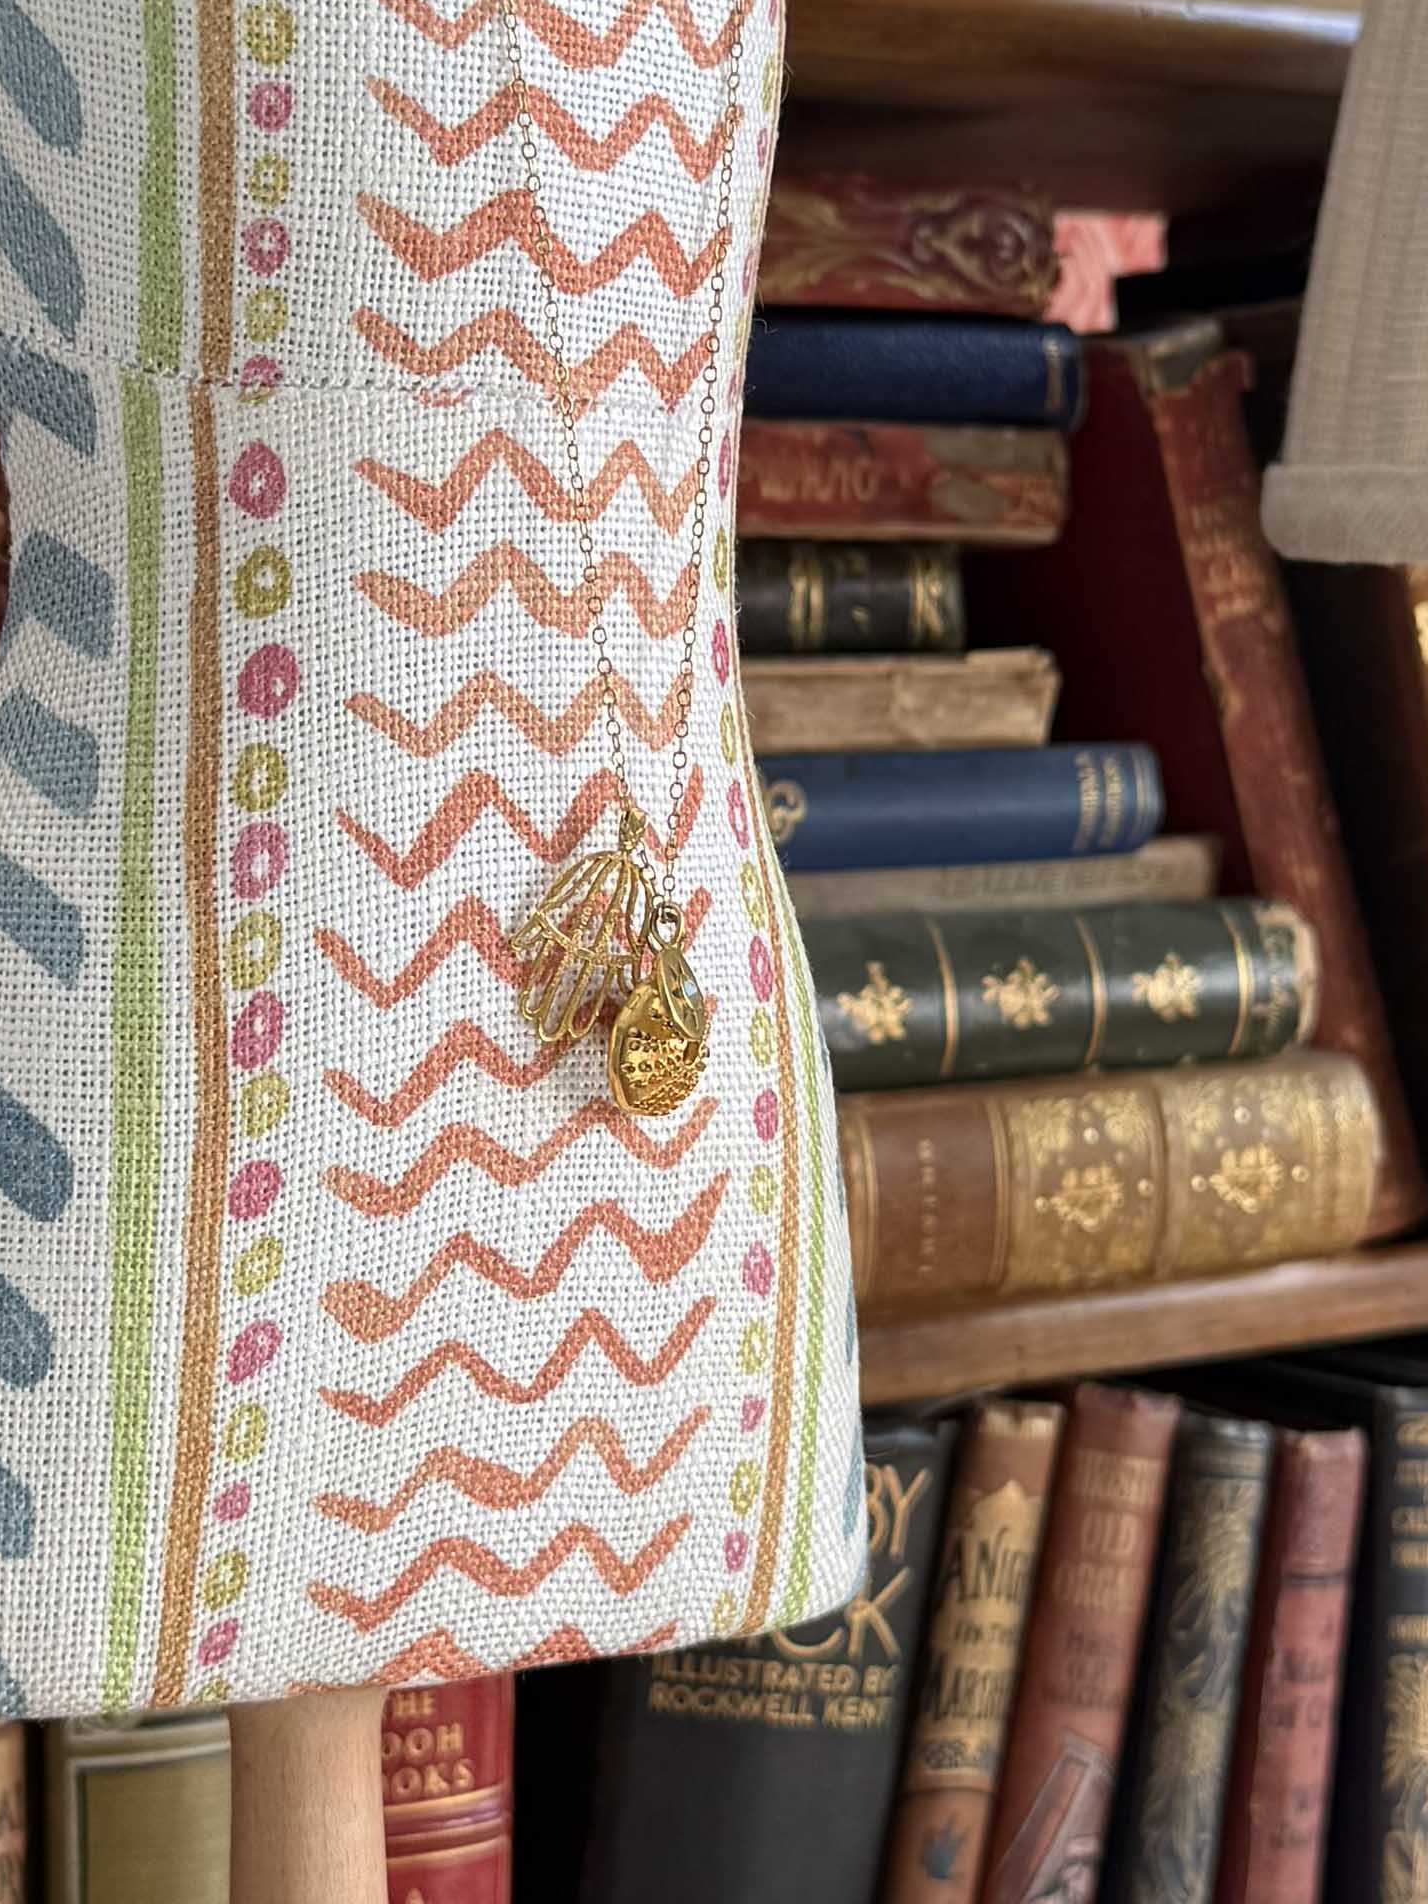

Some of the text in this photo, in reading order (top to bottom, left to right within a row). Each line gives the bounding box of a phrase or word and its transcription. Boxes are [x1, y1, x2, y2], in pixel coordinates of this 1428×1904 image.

[654, 1652, 855, 1695] ILLUSTRATED
[863, 1663, 900, 1698] BY
[648, 1683, 892, 1729] ROCKWELL KENT
[382, 1722, 465, 1765] OOH
[382, 1758, 475, 1801] OKS
